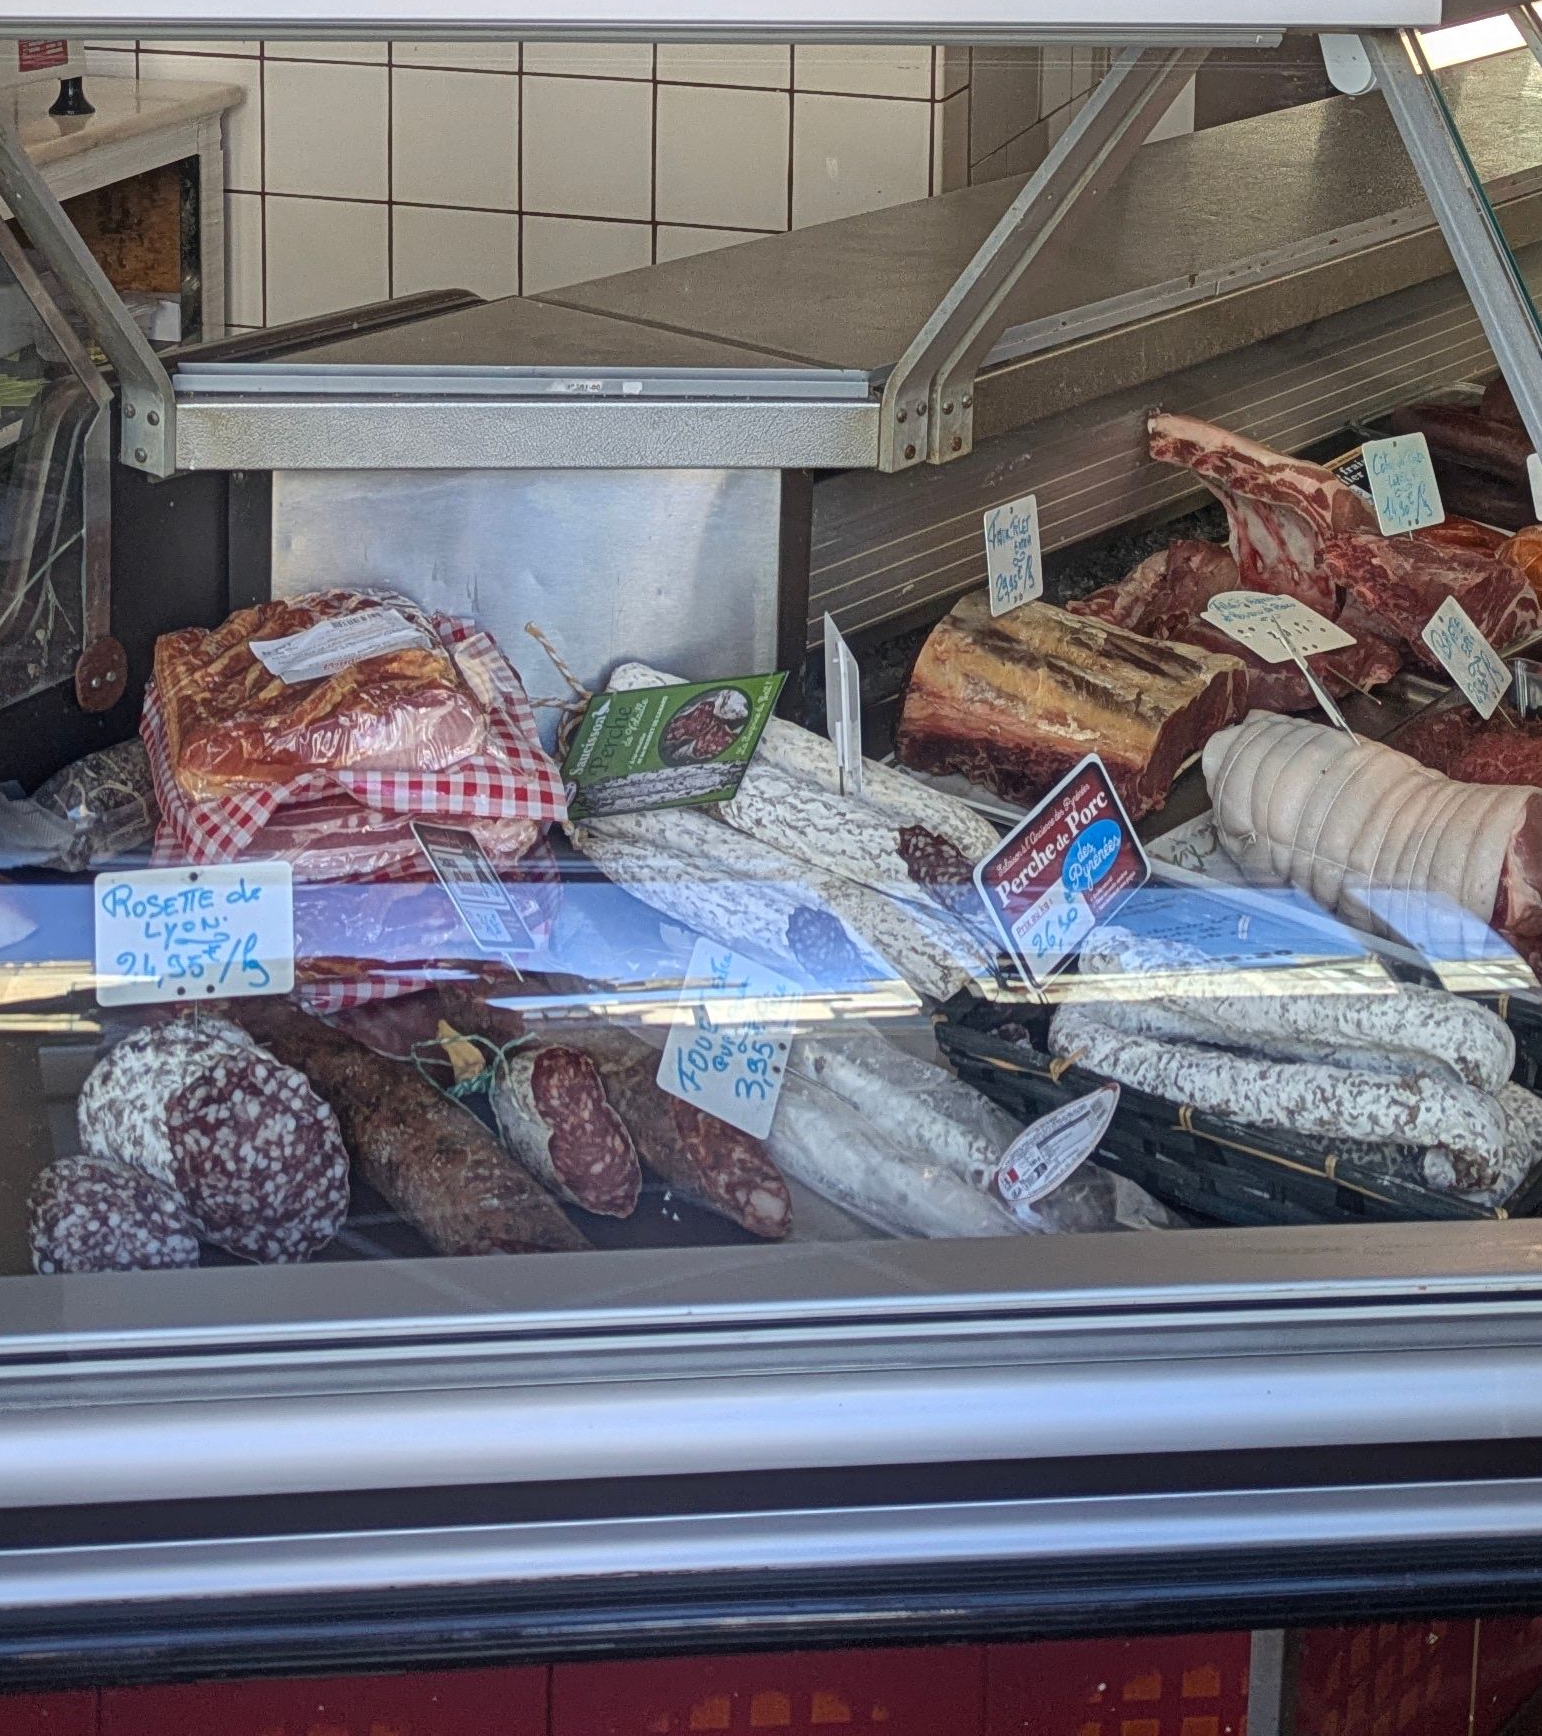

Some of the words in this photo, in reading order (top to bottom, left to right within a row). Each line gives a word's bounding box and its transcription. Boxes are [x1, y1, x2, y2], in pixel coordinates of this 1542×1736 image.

[569, 710, 607, 777] Saucisson
[994, 843, 1057, 909] Perche
[1056, 832, 1071, 852] de
[1064, 790, 1109, 838] Porc
[1068, 833, 1122, 892] Pyrénées
[1076, 841, 1096, 861] des
[102, 883, 215, 919] ROSETTE
[225, 877, 263, 905] de
